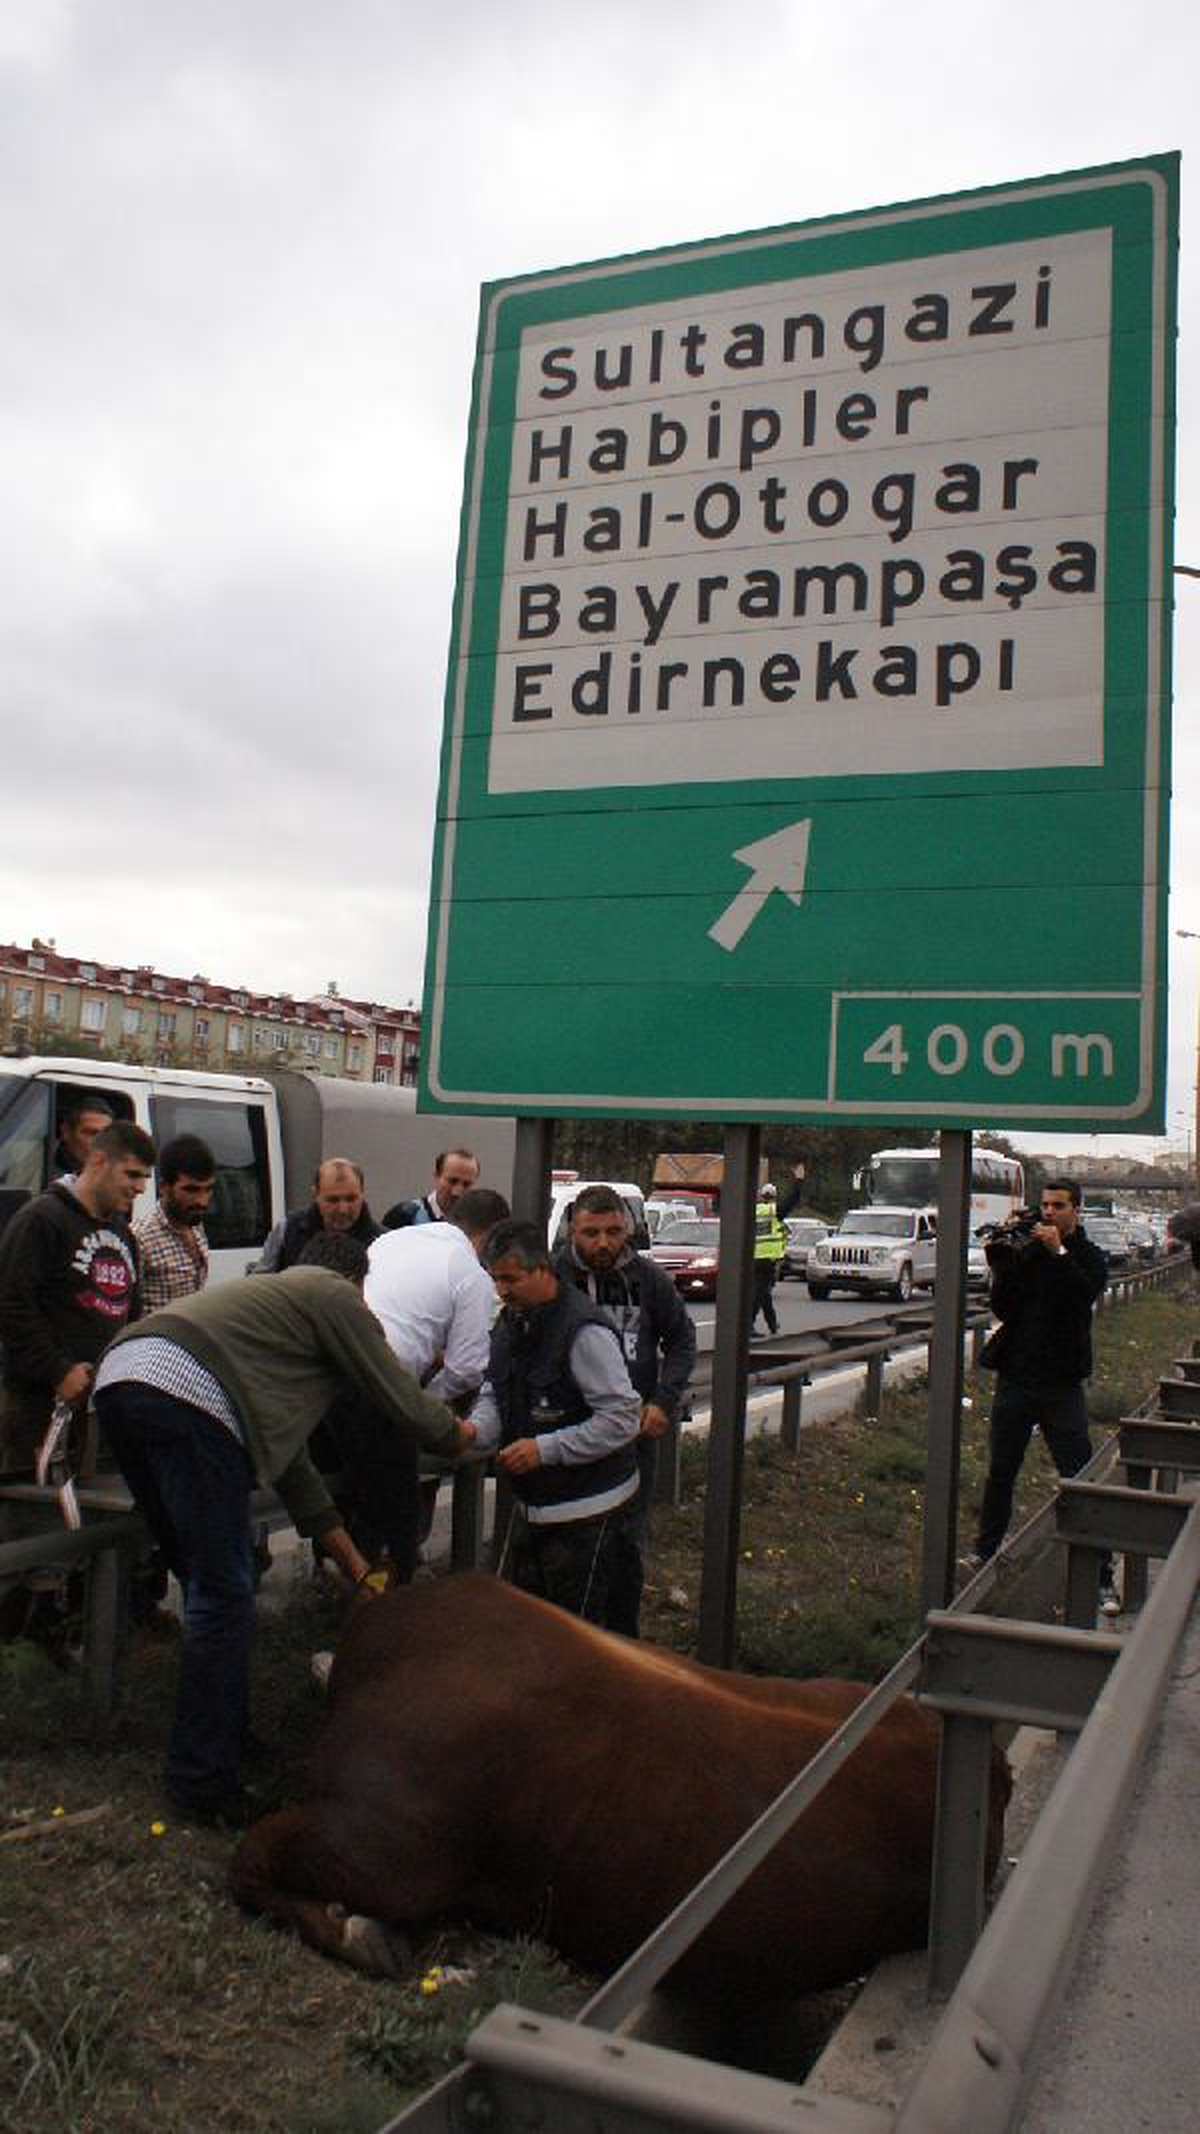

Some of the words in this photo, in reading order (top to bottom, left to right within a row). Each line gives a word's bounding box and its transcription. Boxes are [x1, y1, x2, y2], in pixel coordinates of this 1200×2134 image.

[538, 265, 1052, 401] Sultangazi
[527, 386, 930, 484] Habipler
[522, 458, 1040, 563] Hal-Otogar
[517, 540, 1098, 647] Bayrampaşa
[511, 638, 1016, 724] Edirnekapı
[863, 1023, 1025, 1076] 400
[1051, 1033, 1114, 1077] m
